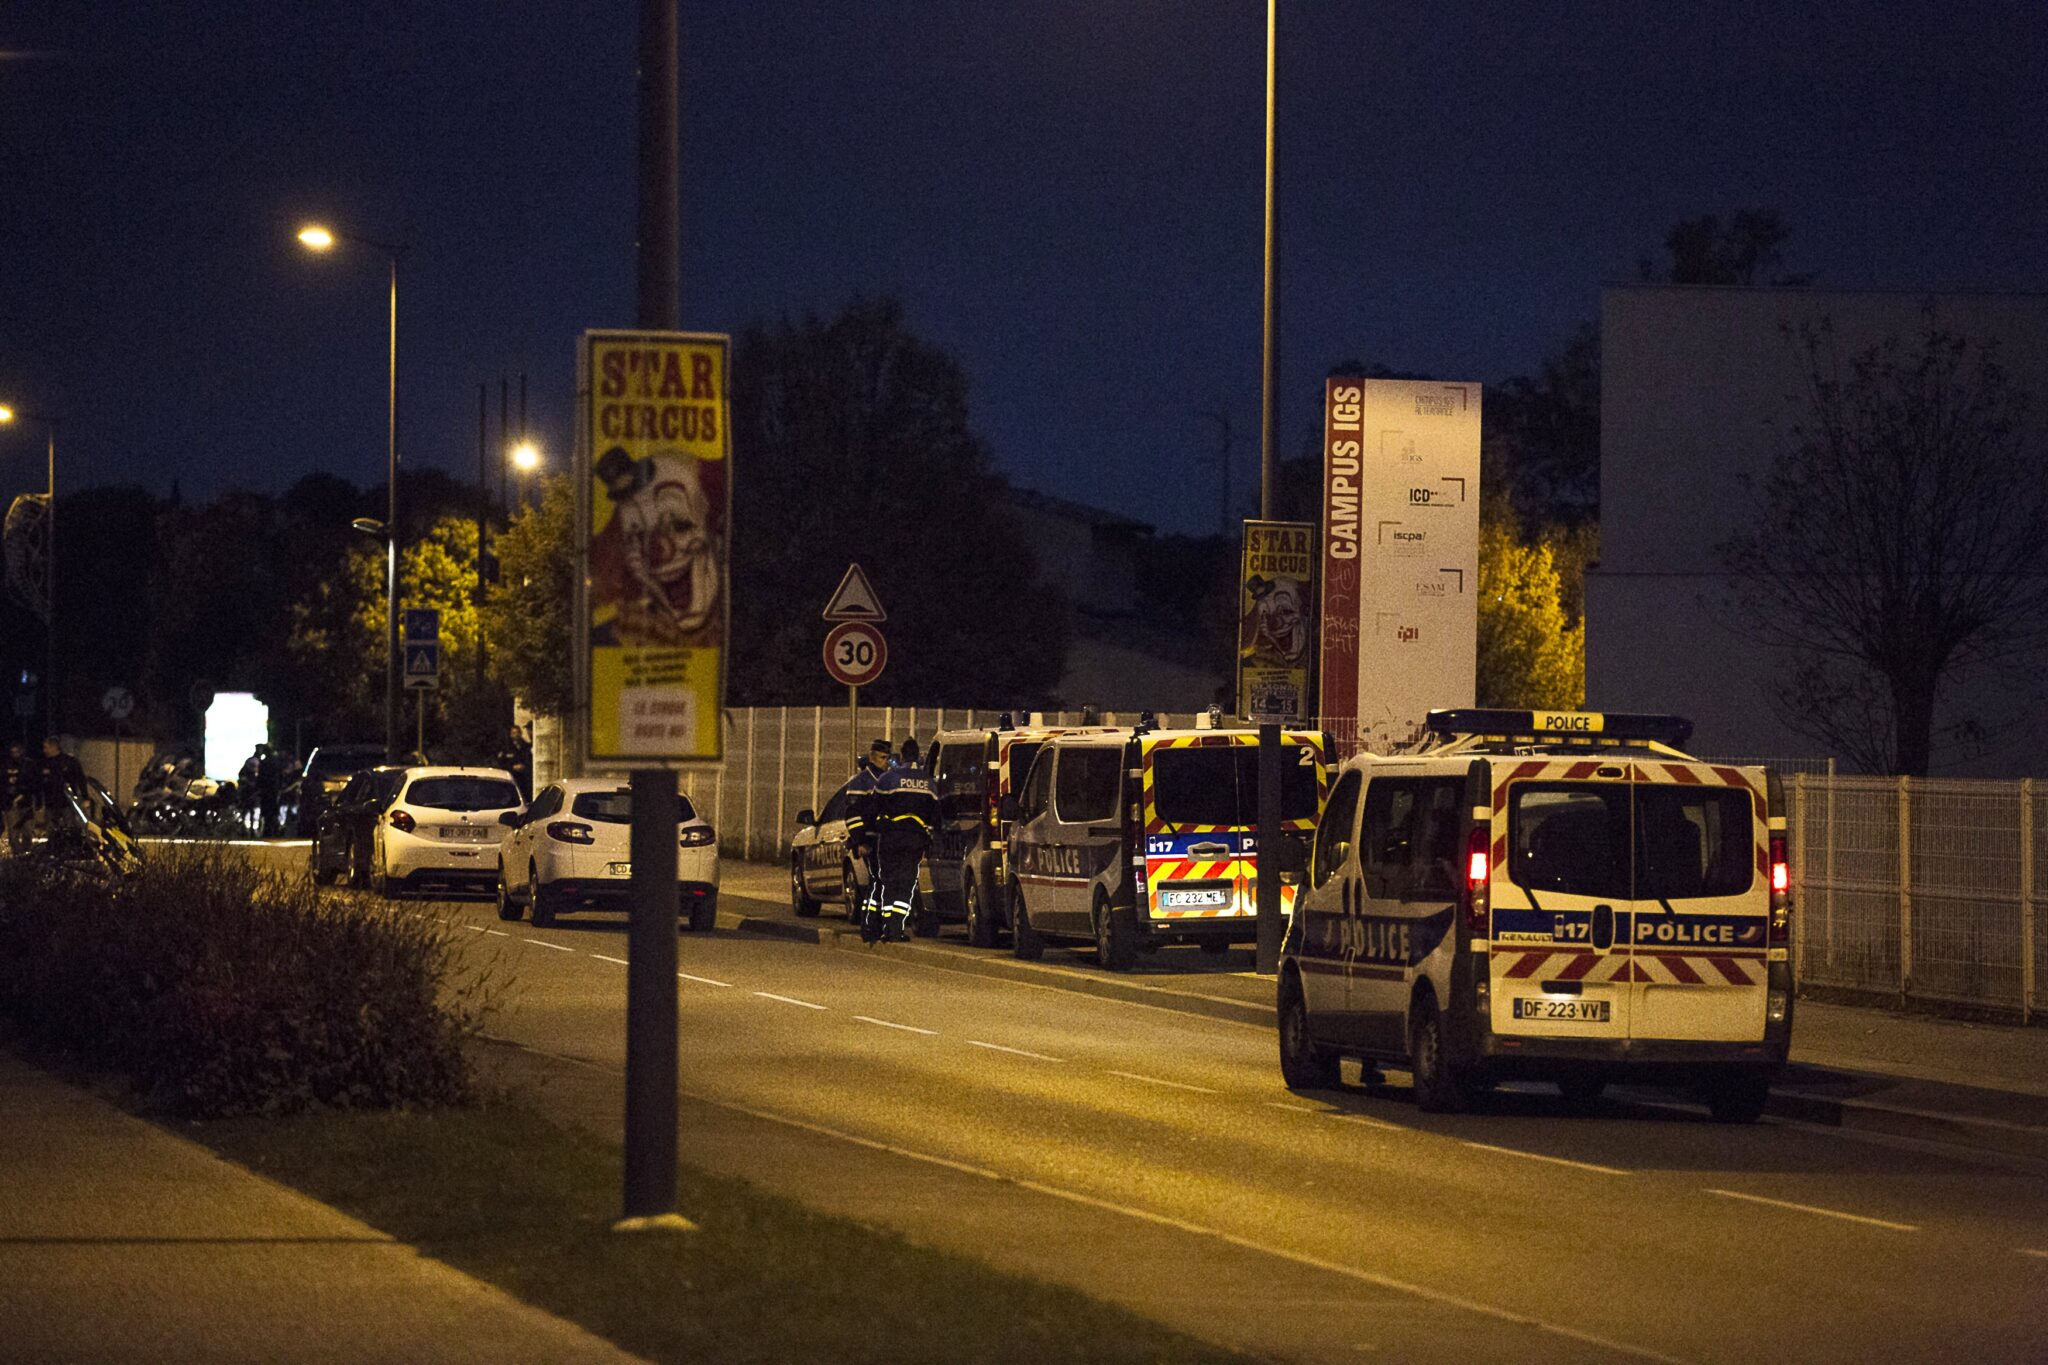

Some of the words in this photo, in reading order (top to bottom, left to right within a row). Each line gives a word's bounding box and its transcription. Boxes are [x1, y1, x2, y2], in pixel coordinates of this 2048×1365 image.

[601, 349, 715, 399] STAR
[1332, 386, 1362, 431] IGS
[601, 404, 717, 443] CIRCUS
[1330, 441, 1361, 560] CAMPUS
[1410, 488, 1430, 502] ICD
[1250, 529, 1308, 554] STAR
[1249, 554, 1308, 573] CIRCUS
[839, 640, 873, 666] 30
[1546, 716, 1590, 730] POLICE
[1298, 746, 1315, 766] 2
[900, 778, 929, 790] POLICE
[1157, 841, 1174, 853] 17
[1036, 846, 1080, 874] POLICE
[1185, 892, 1203, 904] 232
[1340, 919, 1410, 960] POLICE
[1565, 922, 1590, 939] 17
[1637, 922, 1735, 944] POLICE
